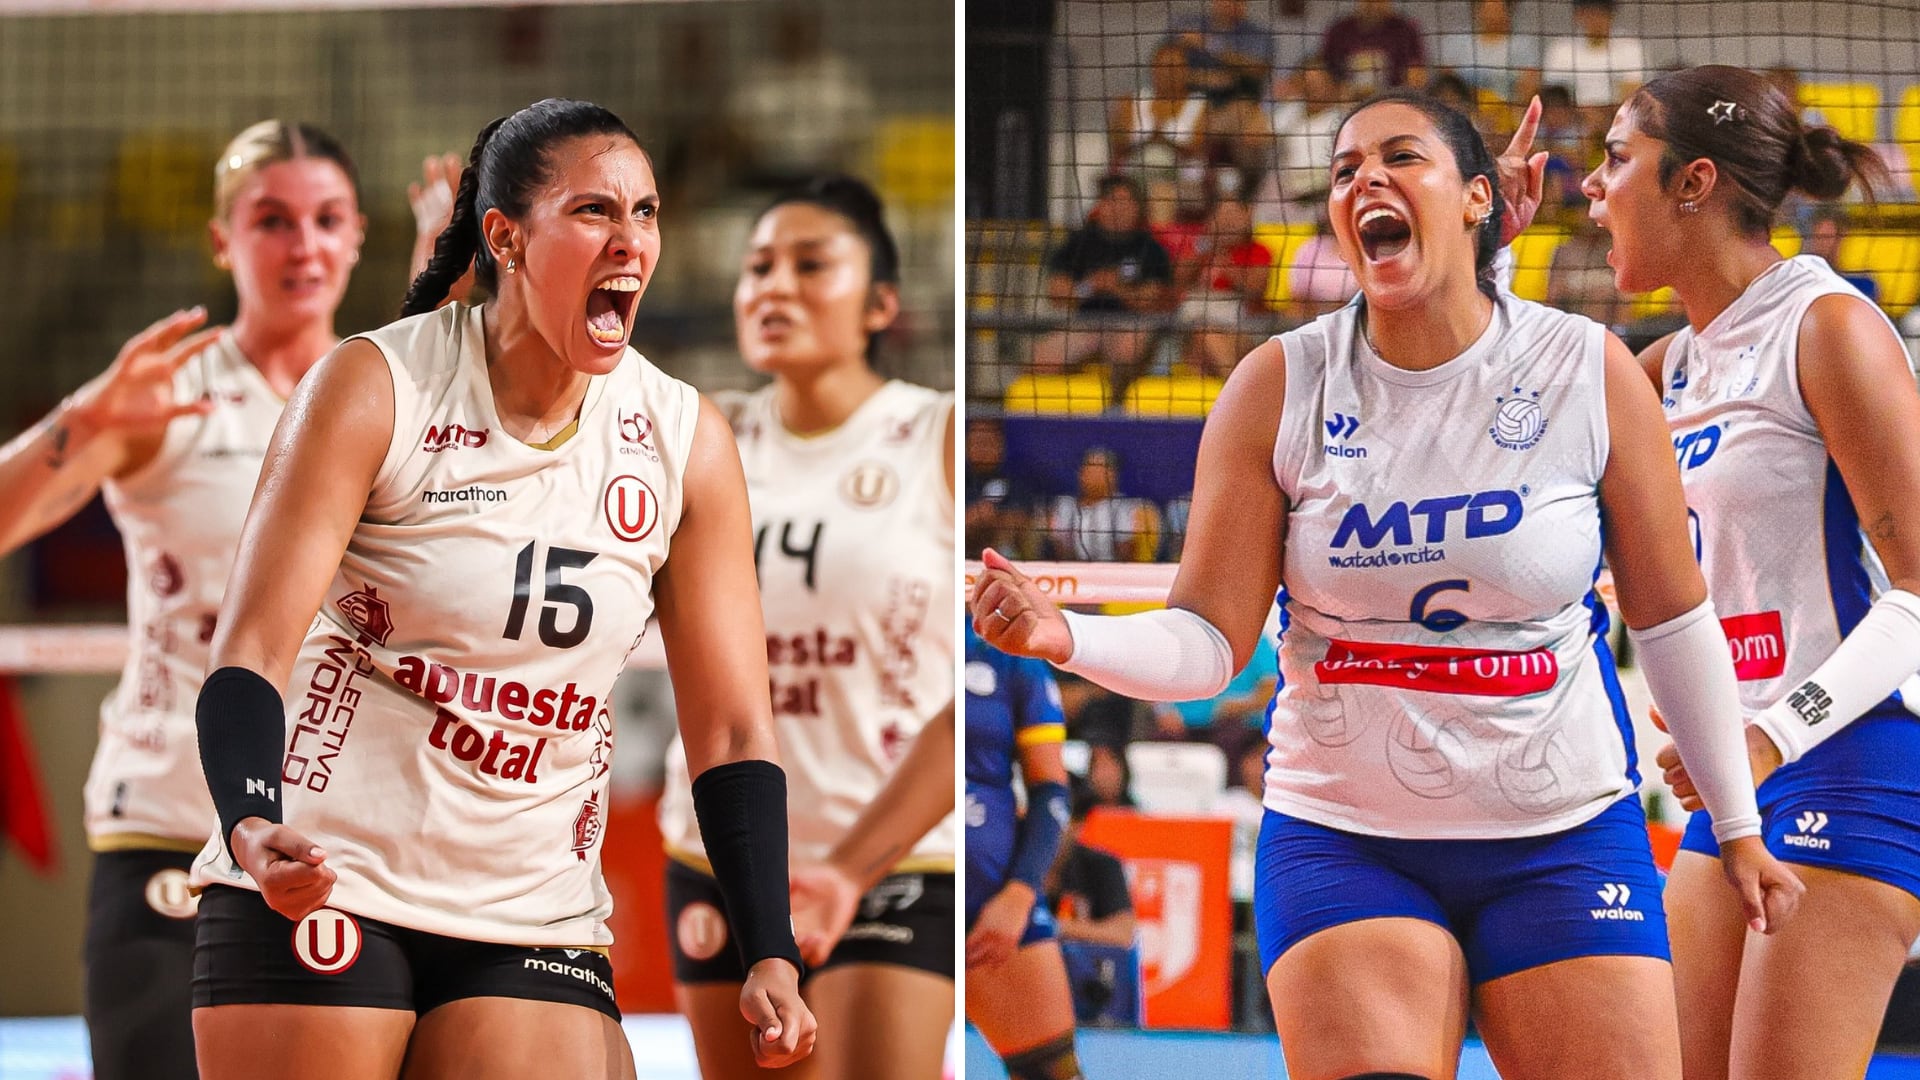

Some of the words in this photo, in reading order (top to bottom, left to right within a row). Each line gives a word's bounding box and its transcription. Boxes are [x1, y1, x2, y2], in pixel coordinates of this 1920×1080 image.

[1323, 444, 1368, 459] alon
[1673, 424, 1722, 470] TD
[421, 486, 508, 503] marathon
[617, 486, 646, 533] U
[1329, 489, 1524, 550] MTD
[1328, 546, 1446, 569] matadorcita
[502, 538, 600, 649] 15
[1409, 579, 1470, 633] 6
[1731, 630, 1778, 664] orm
[281, 634, 354, 786] WORLD
[393, 655, 597, 732] apuesta
[427, 707, 548, 784] total
[1783, 832, 1831, 851] walon
[1590, 907, 1645, 922] walon
[308, 919, 345, 966] U
[523, 957, 615, 1002] marathon
